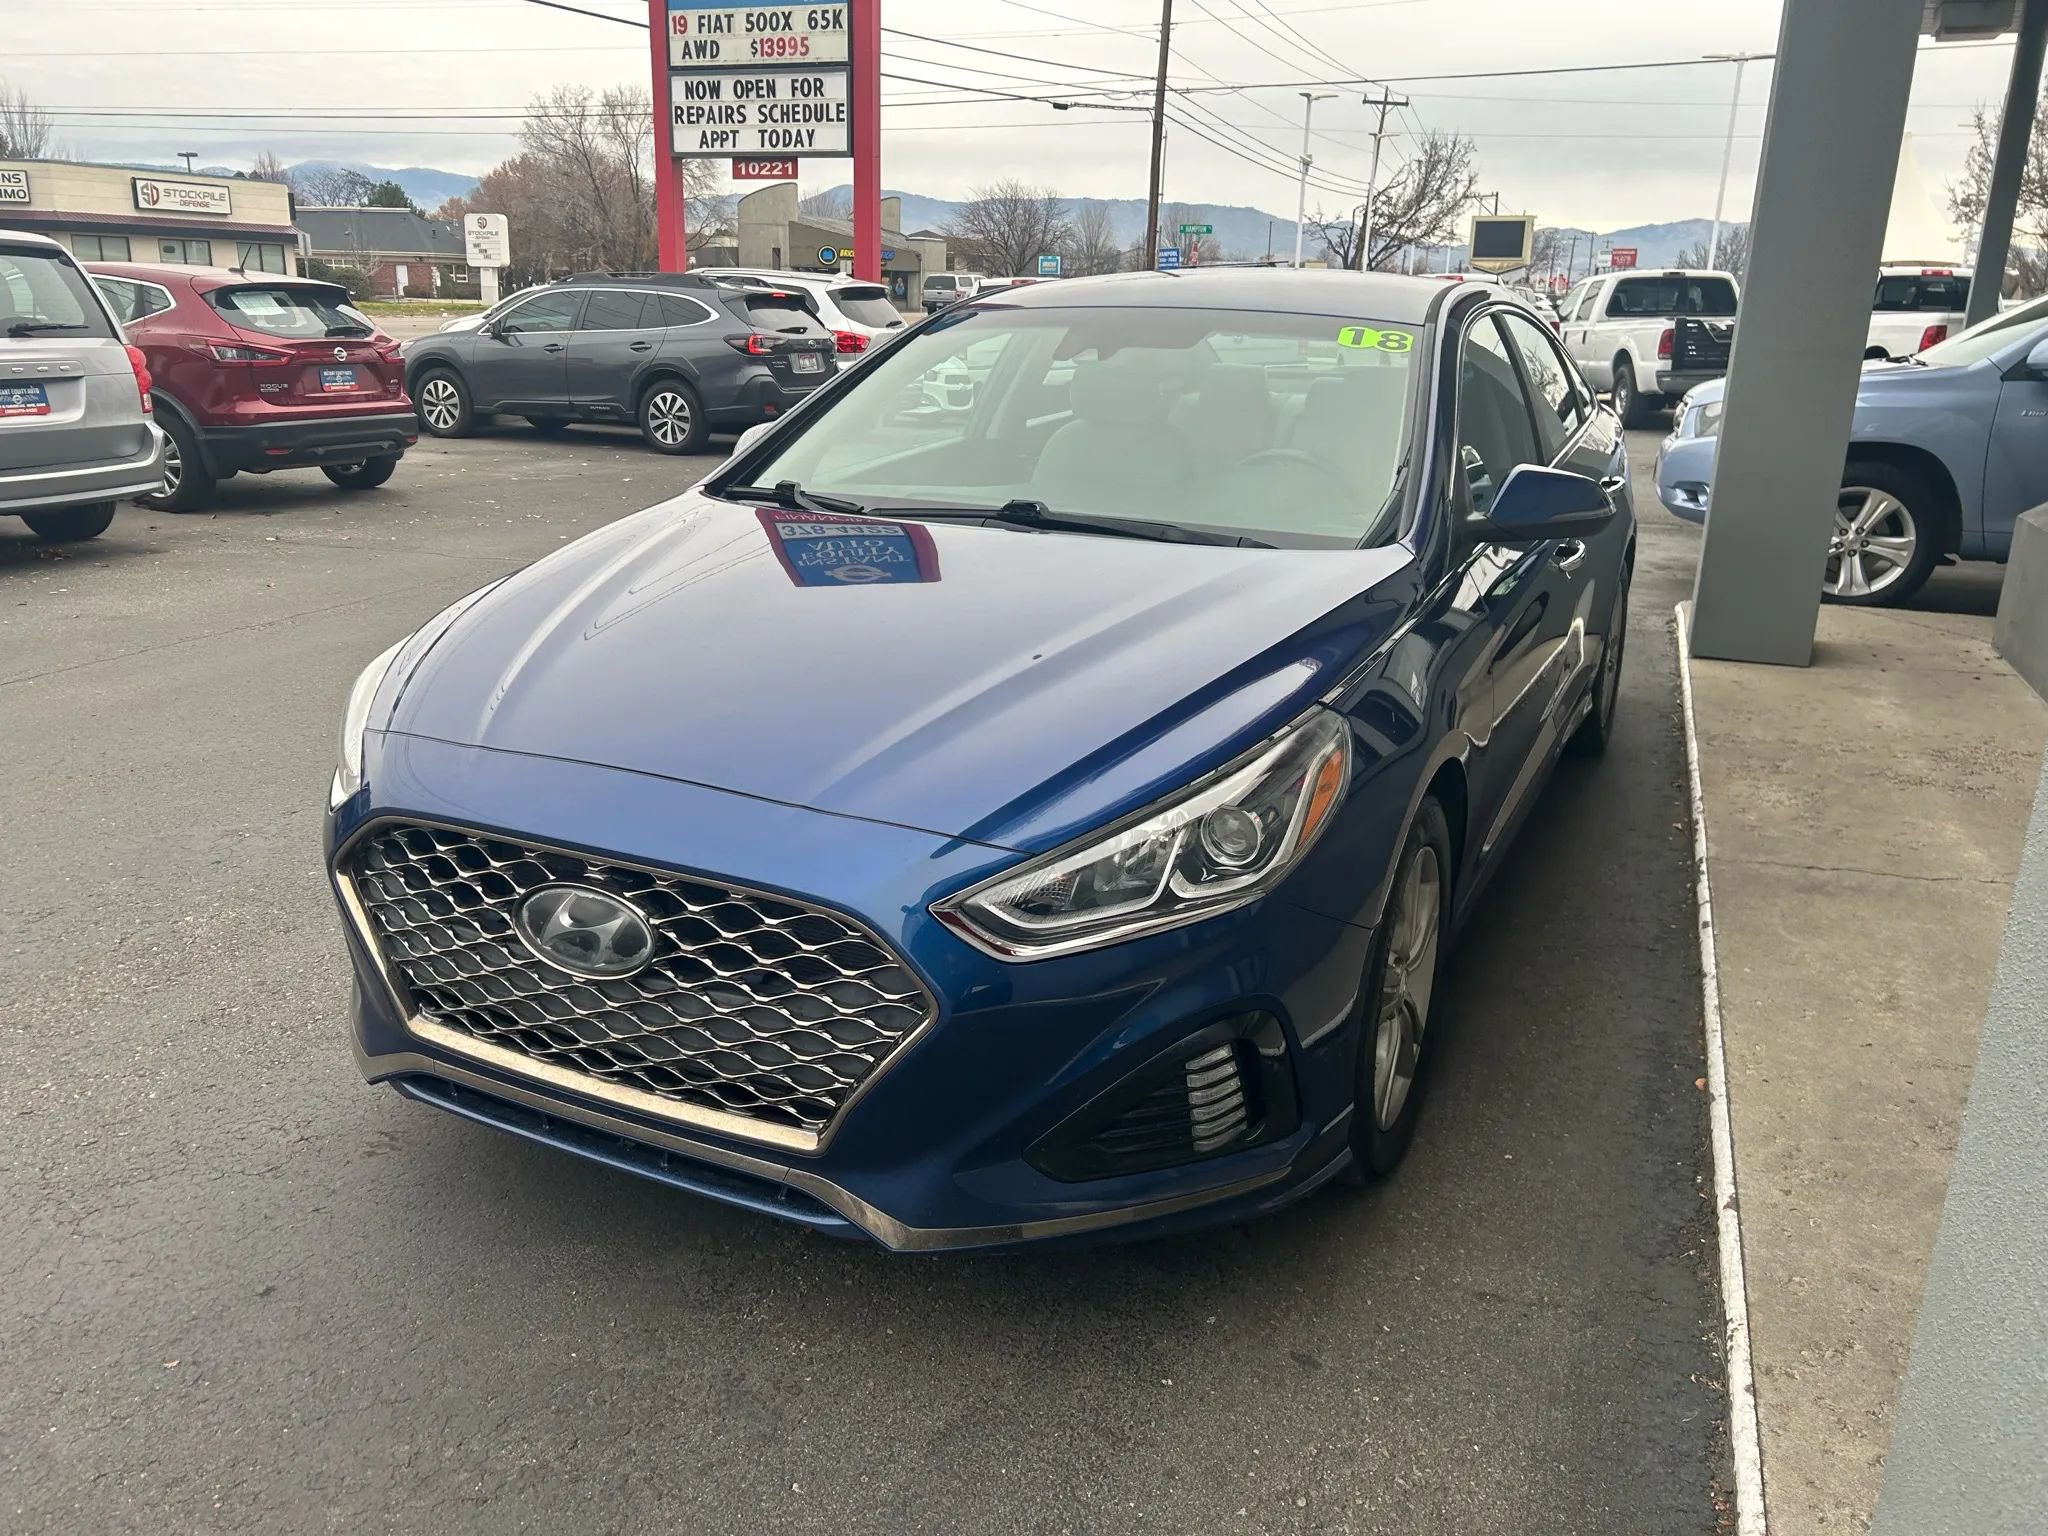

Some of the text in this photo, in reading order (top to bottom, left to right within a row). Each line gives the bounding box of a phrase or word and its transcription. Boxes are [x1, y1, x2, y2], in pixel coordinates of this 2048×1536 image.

[671, 9, 844, 35] 19 FIAT 500X 65K
[682, 36, 810, 60] AWD $13995
[684, 77, 825, 100] NOW OPEN FOR
[674, 102, 845, 125] REPAIRS SCHEDULE
[699, 128, 816, 149] APPT TODAY
[1, 173, 22, 184] NS
[737, 161, 794, 176] 10221
[0, 188, 27, 199] MO
[163, 188, 226, 201] STOCKPILE
[179, 199, 211, 208] DEFENSE
[1347, 328, 1409, 350] 18
